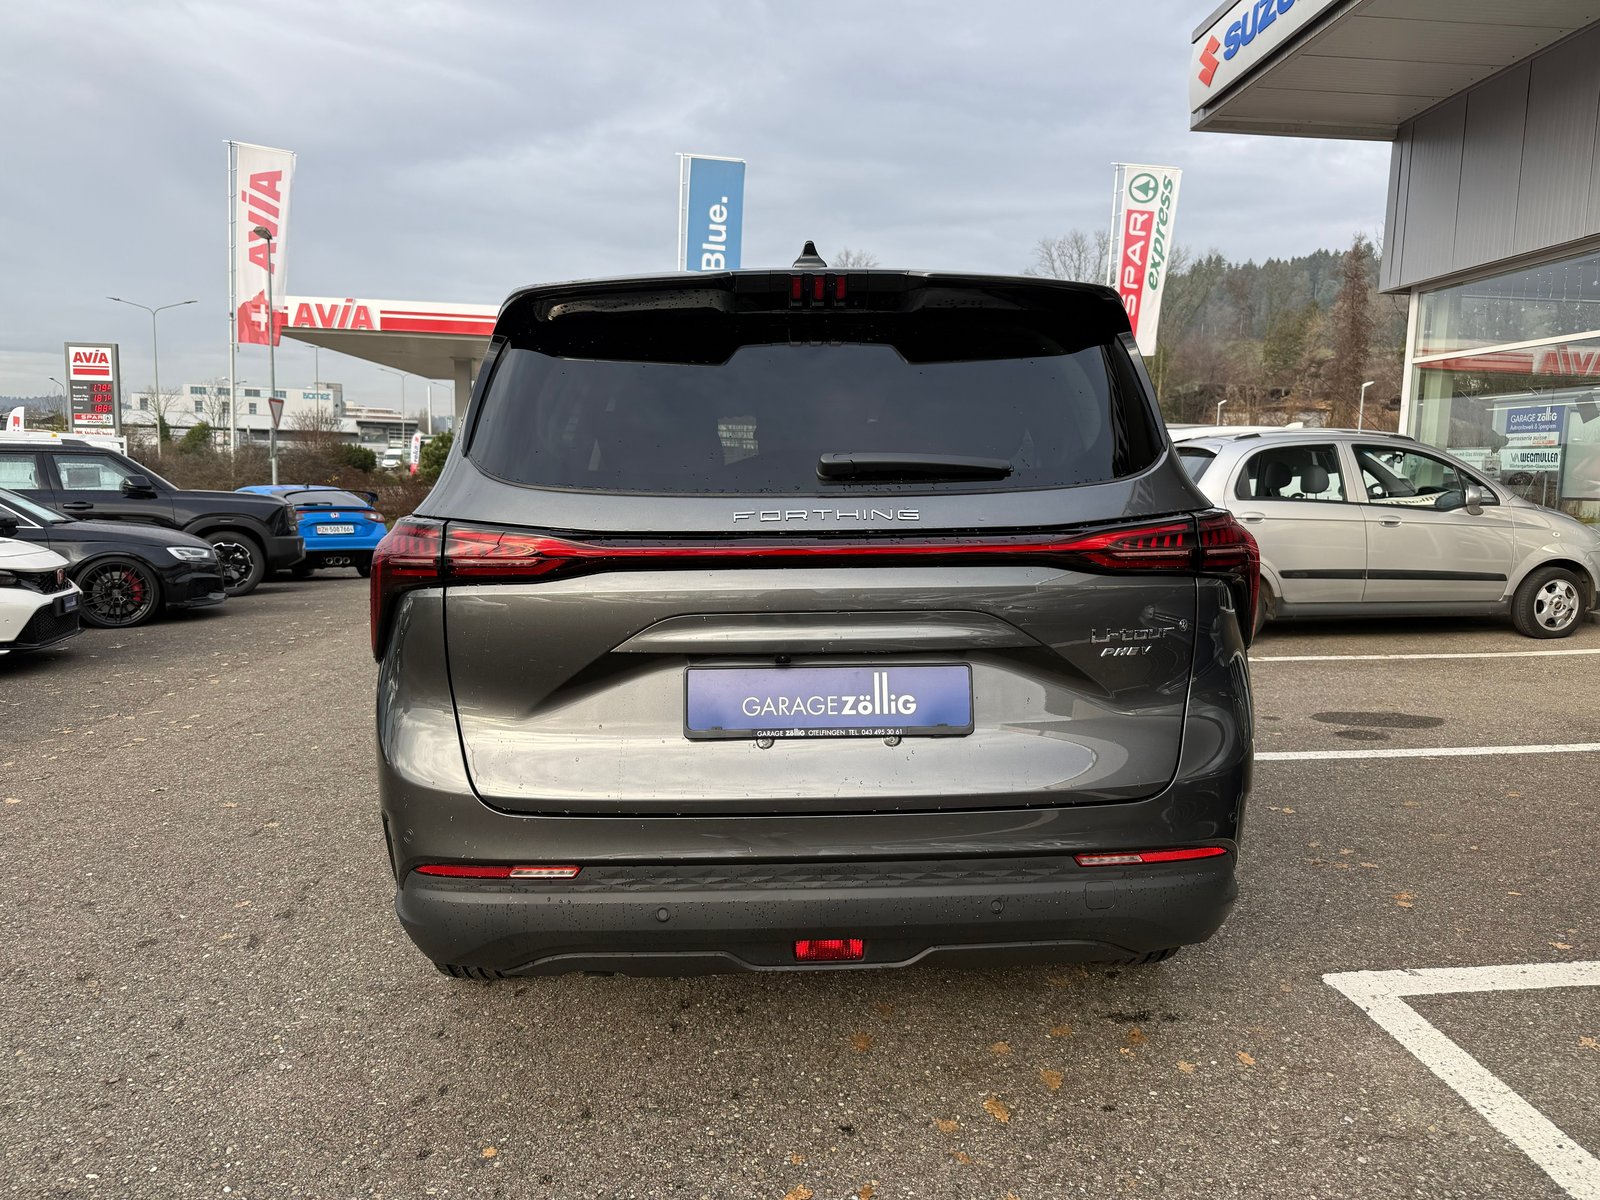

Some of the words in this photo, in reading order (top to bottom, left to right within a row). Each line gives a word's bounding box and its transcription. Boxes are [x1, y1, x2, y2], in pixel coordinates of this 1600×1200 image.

[701, 196, 729, 271] Blue.
[1148, 175, 1174, 291] express
[1122, 212, 1150, 317] SPAR
[1510, 413, 1536, 424] GARAGE
[733, 509, 920, 523] FORTHING
[1100, 643, 1153, 657] PHEV
[742, 696, 838, 717] GARAGE
